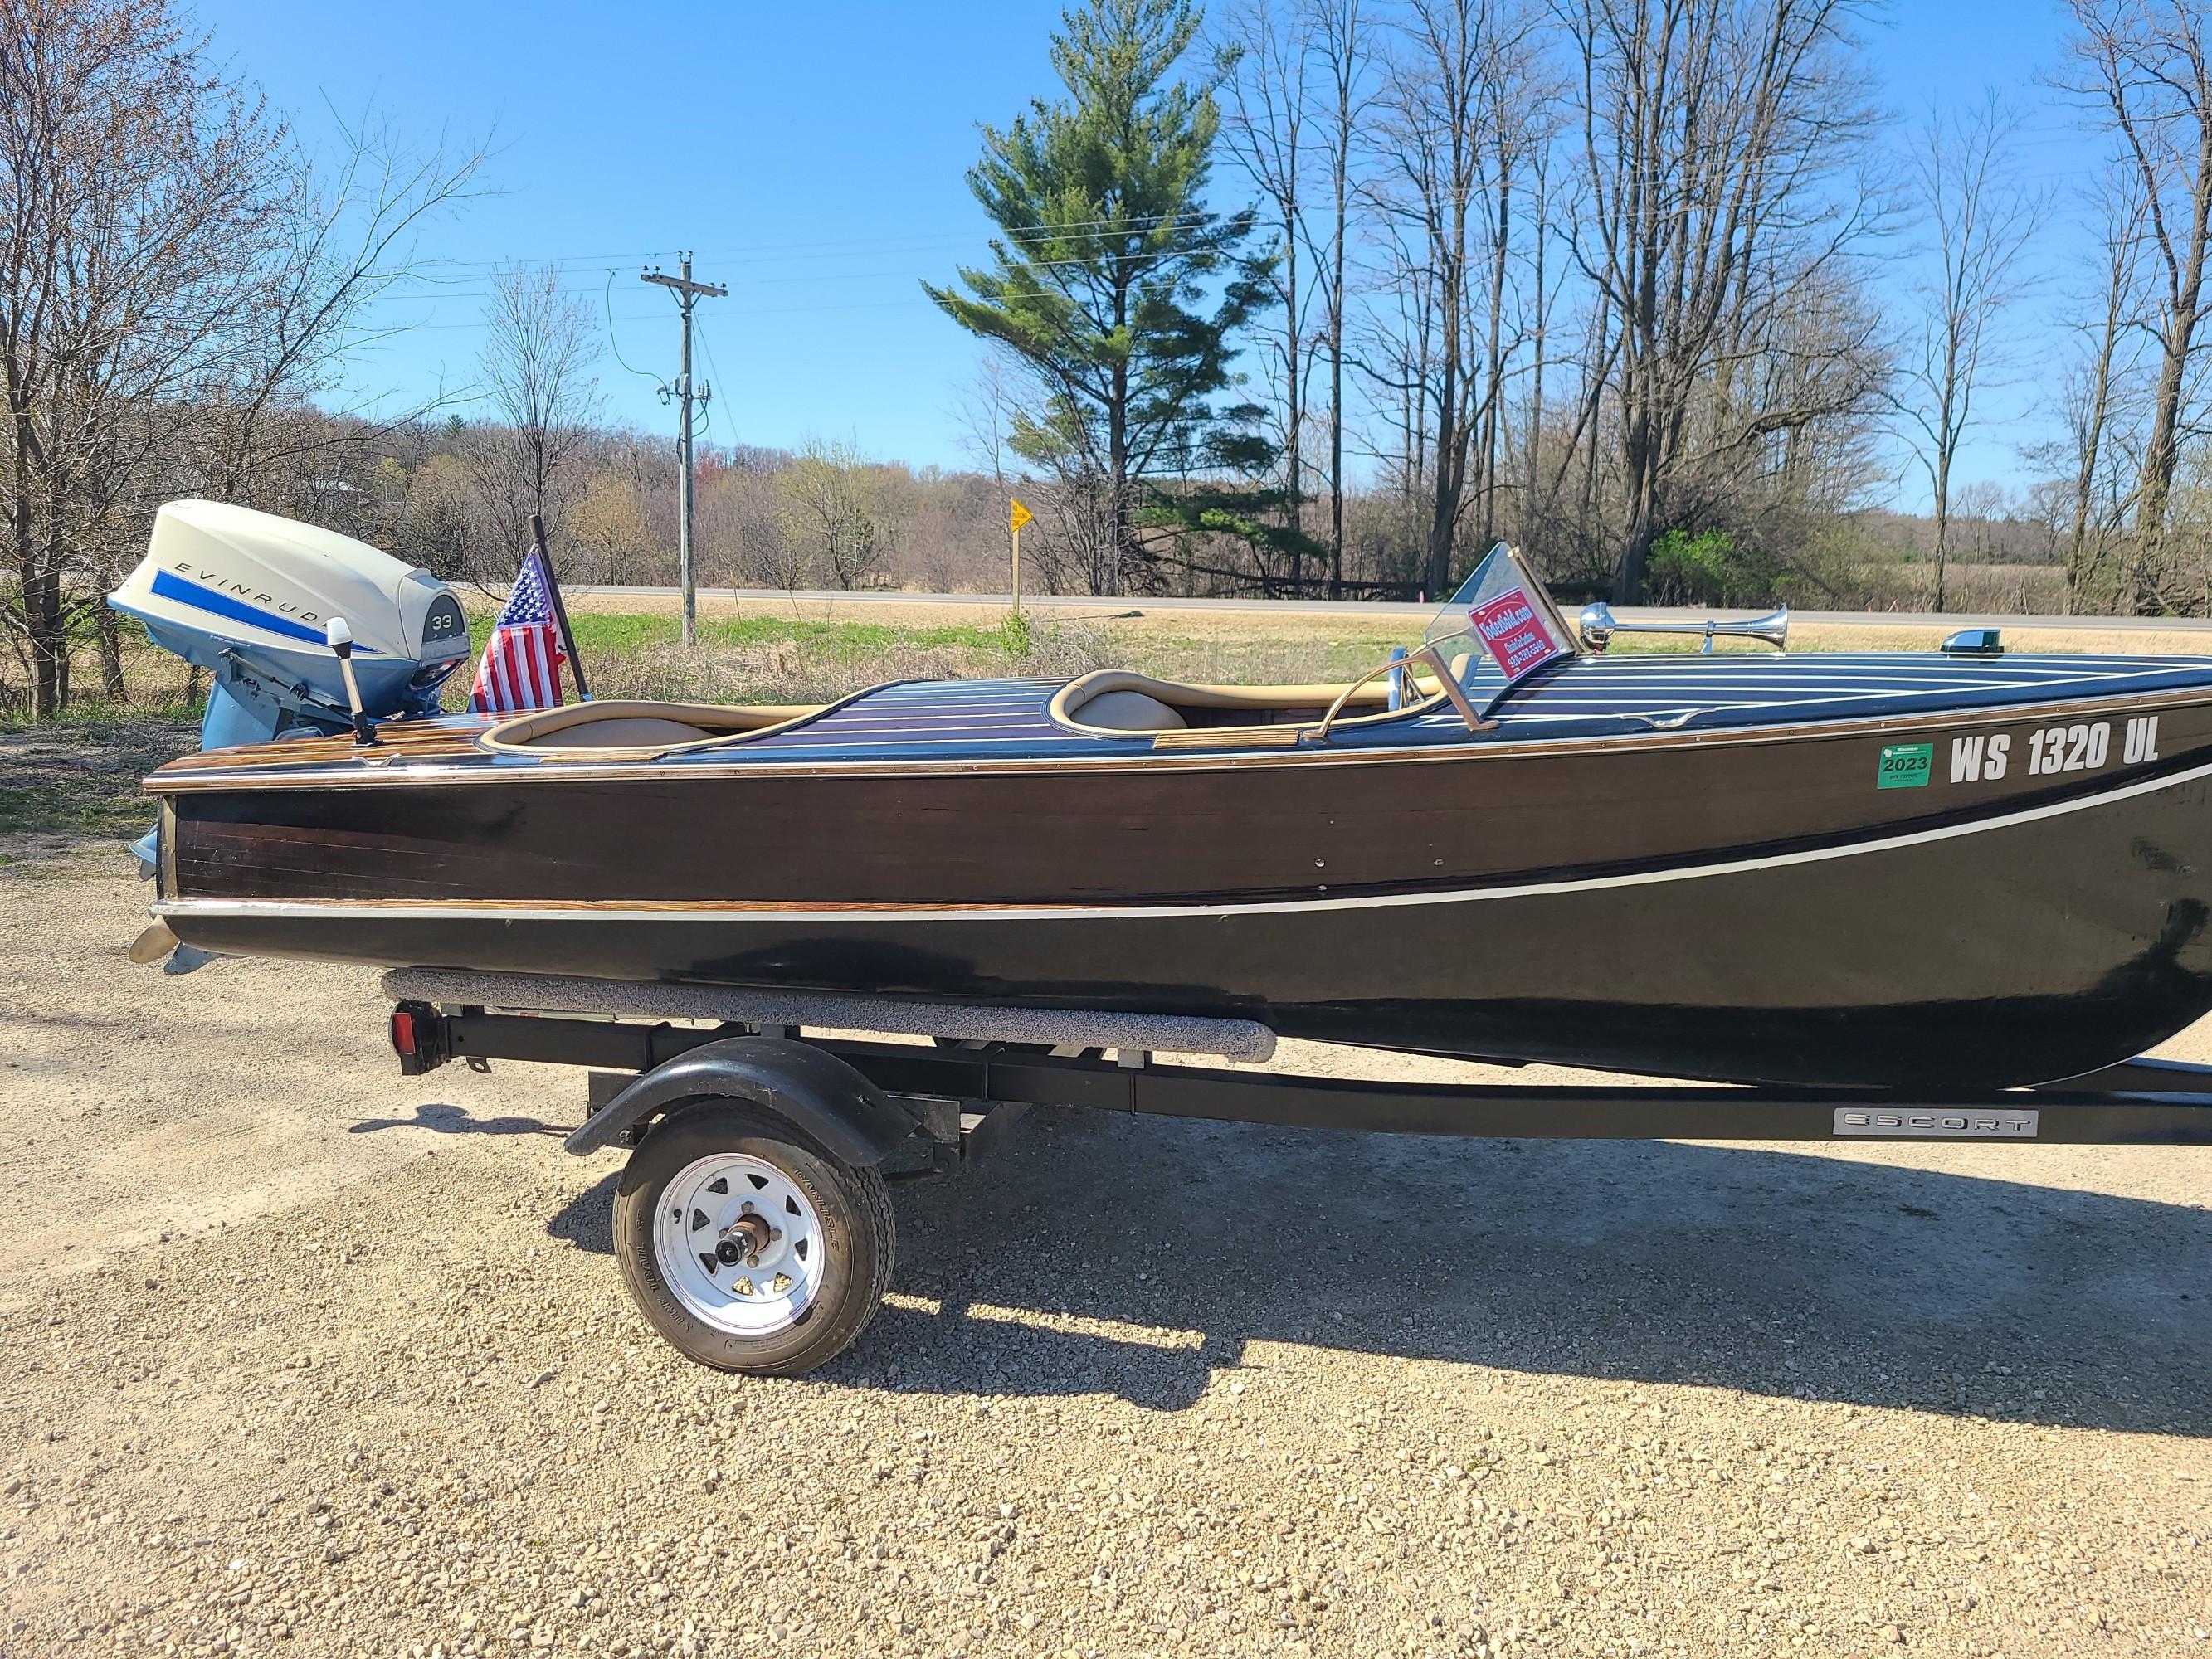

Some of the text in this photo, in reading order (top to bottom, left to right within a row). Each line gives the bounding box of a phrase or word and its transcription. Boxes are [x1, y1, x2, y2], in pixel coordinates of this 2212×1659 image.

[174, 562, 328, 628] EVINRUD
[431, 615, 452, 630] 33
[1883, 757, 1927, 772] 2023
[1950, 716, 2159, 784] WS 1320 UL
[1844, 1113, 2032, 1132] ESCORT
[794, 1169, 840, 1252] CARLISLE
[636, 1242, 660, 1294] TRAIL
